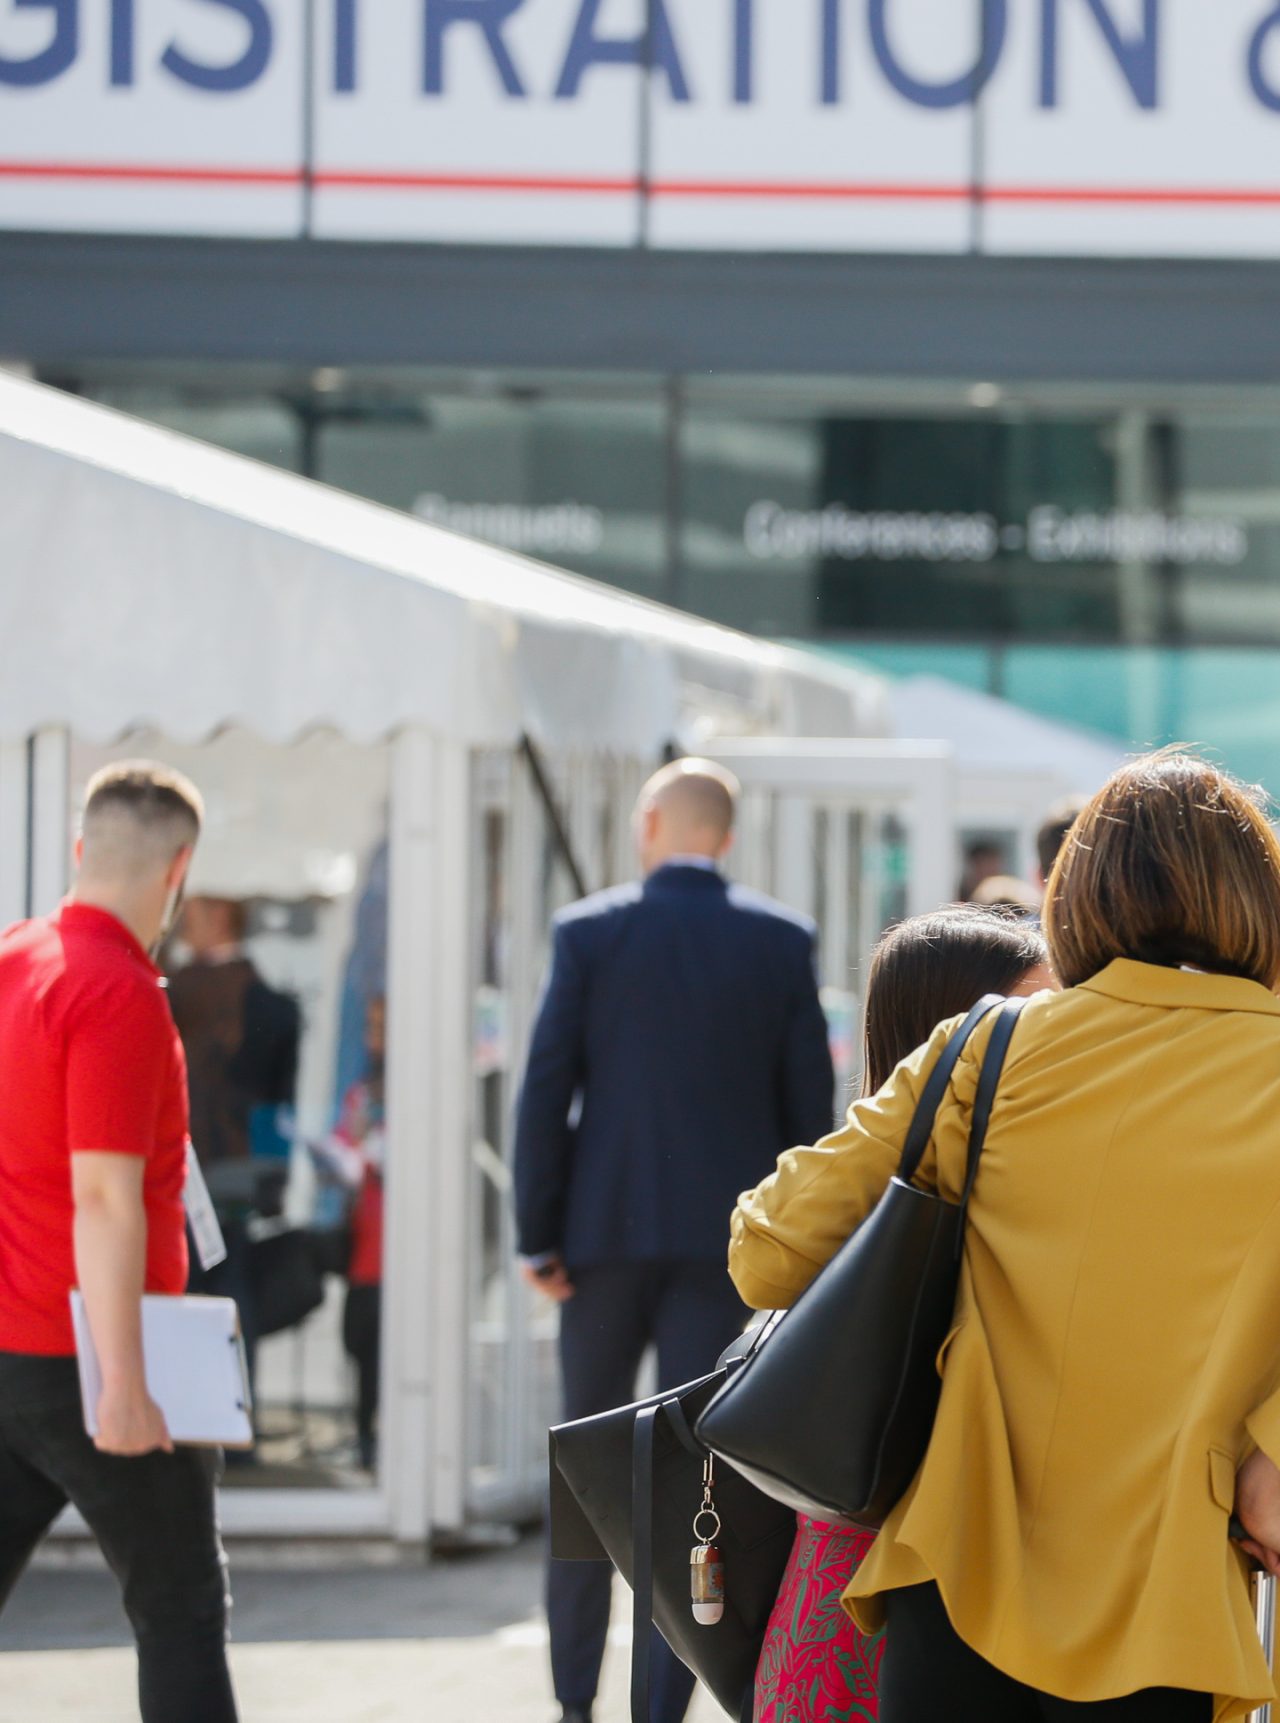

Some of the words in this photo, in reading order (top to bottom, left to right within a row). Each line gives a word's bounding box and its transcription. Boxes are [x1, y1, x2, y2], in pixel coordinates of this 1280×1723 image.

[0, 0, 1160, 111] ISTRATION
[745, 501, 996, 561] Conferences
[1027, 504, 1247, 565] Exhibitions
